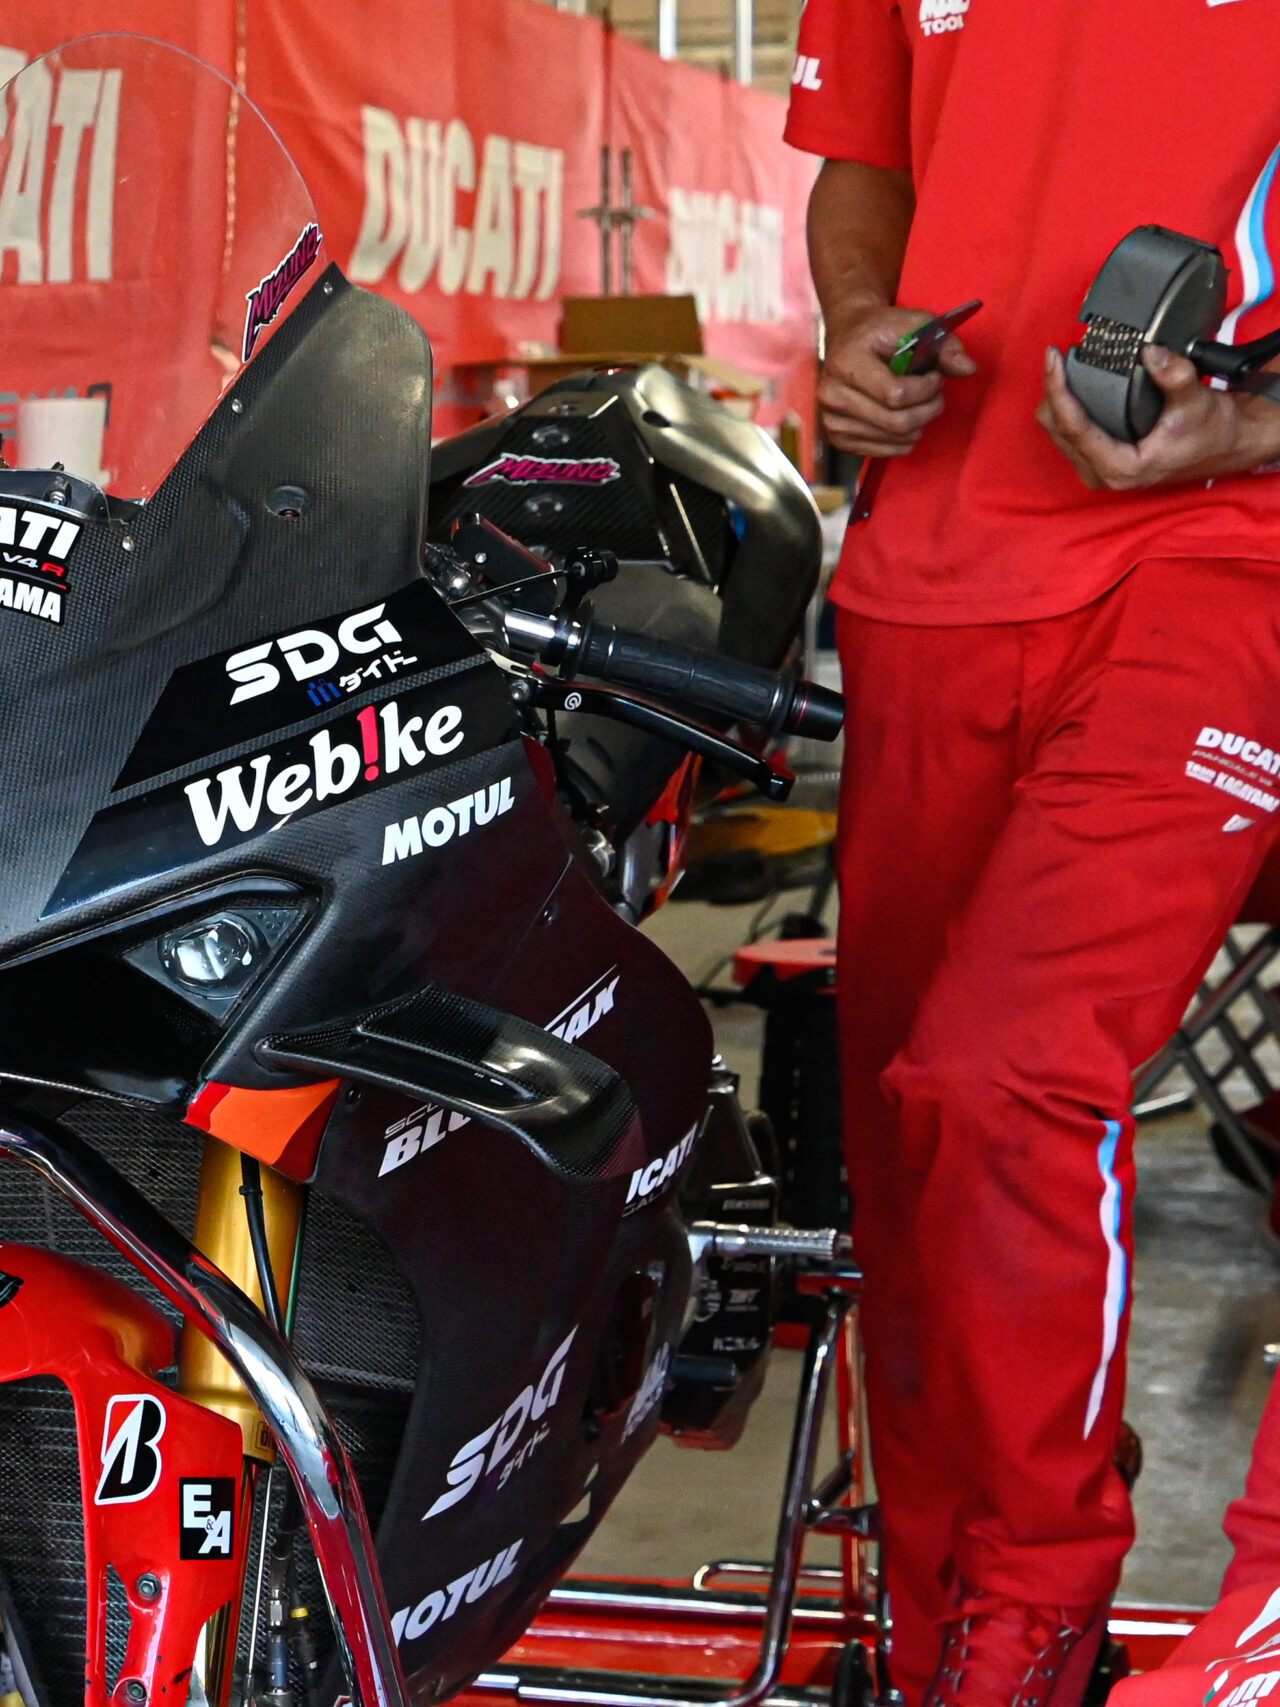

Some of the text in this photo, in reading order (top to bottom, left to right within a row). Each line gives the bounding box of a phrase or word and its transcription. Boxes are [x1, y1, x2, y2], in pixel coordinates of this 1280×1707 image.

[349, 105, 565, 300] DUCATI
[242, 222, 322, 363] MIZUNO
[462, 452, 621, 487] MIZUNO
[225, 603, 403, 705] SDG
[338, 649, 418, 692] ダイドー
[381, 776, 515, 866] MOTUL
[421, 1324, 579, 1521] SDG
